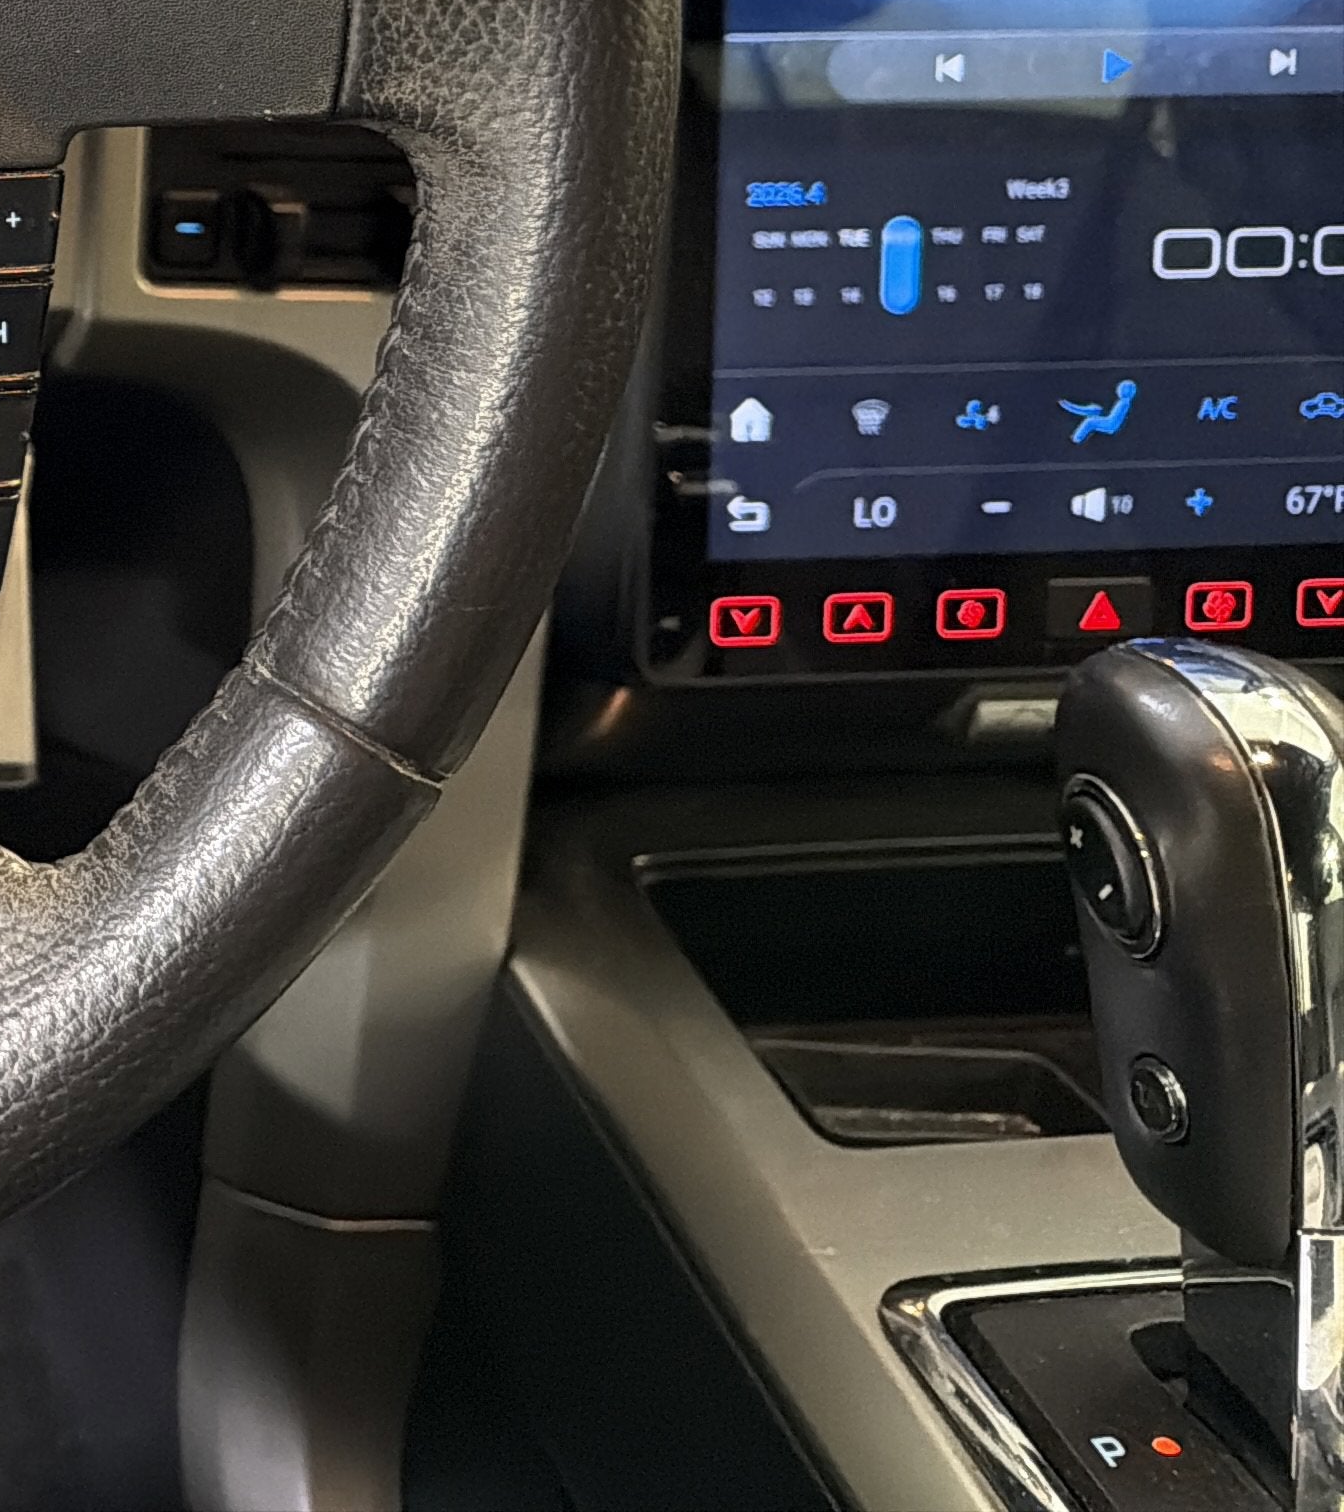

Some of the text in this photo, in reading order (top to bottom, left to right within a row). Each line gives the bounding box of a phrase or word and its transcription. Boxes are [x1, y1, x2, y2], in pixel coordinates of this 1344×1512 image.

[1198, 395, 1238, 420] A/C
[853, 497, 897, 529] LO
[1090, 1436, 1126, 1468] P
